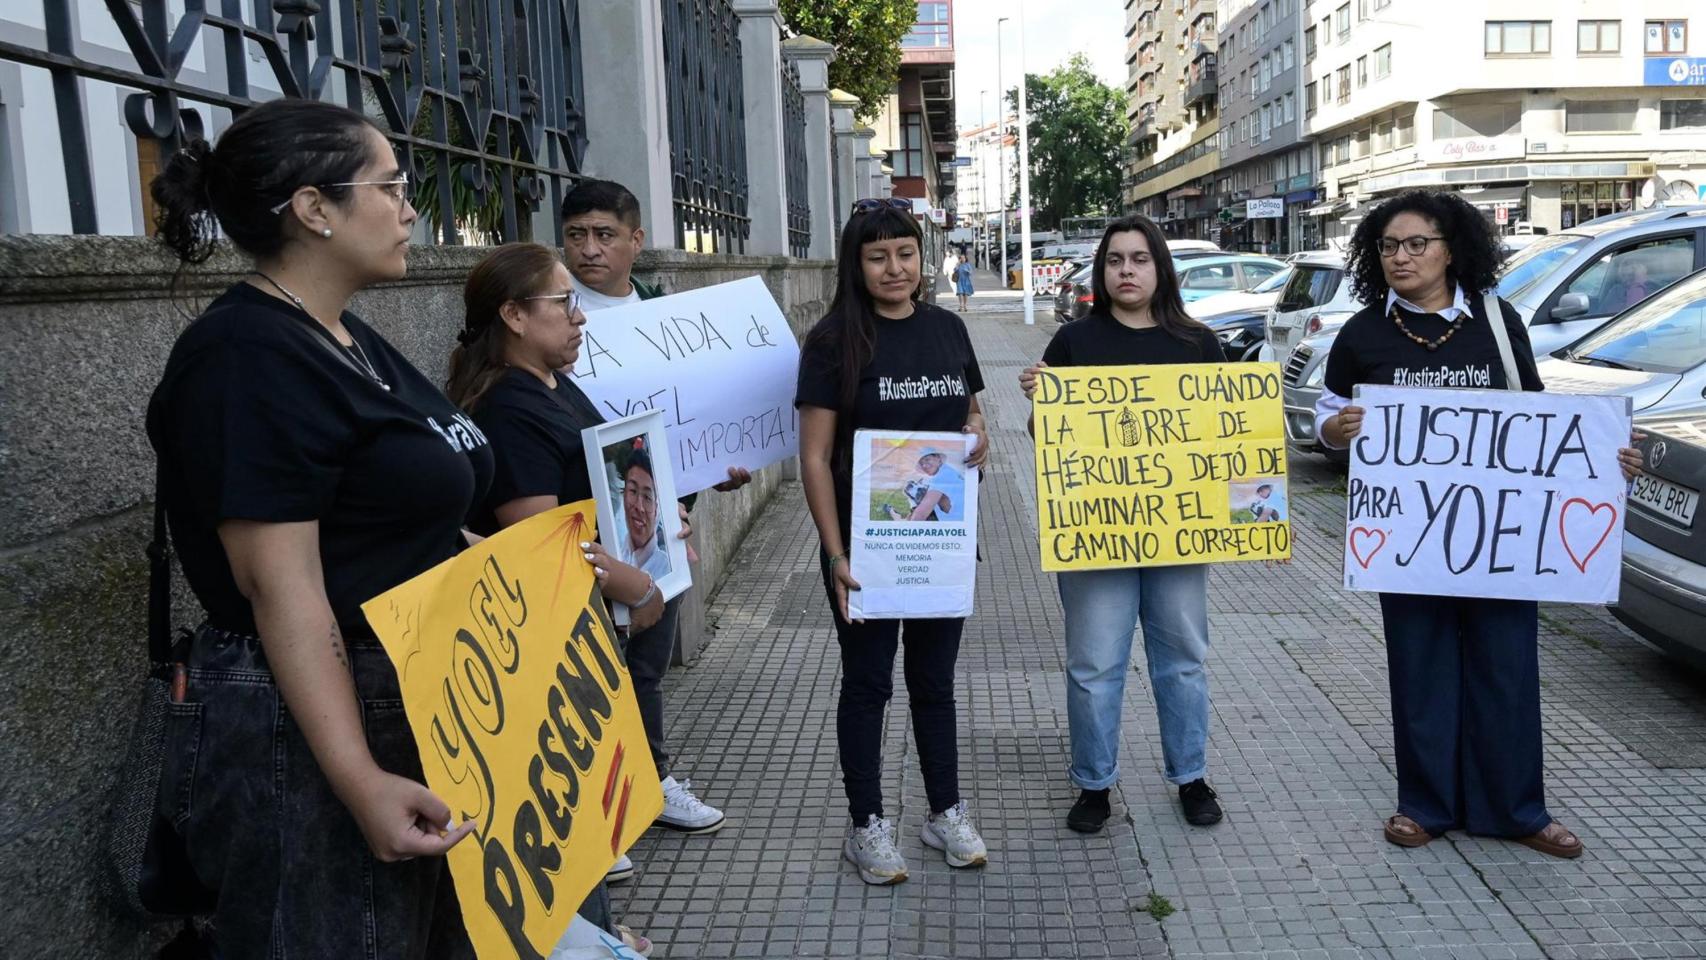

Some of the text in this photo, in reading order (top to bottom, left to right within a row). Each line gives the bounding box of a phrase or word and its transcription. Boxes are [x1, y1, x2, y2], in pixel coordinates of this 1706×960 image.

[635, 312, 732, 361] VIDA
[746, 314, 777, 348] de
[879, 375, 966, 401] #XustizaParaYoel
[1037, 367, 1280, 405] DESDE CUÁNDO
[1393, 364, 1490, 387] #XustizaParaYoel
[679, 404, 796, 472] IMPORTA!
[1043, 414, 1075, 445] LA
[1217, 411, 1252, 439] DE
[1355, 403, 1598, 479] JUSTICIA
[1041, 443, 1285, 496] HÉRCULES DEJÓ DE
[1048, 491, 1213, 530] ILUMINAR EL
[1633, 474, 1691, 520] 5294 BRL
[864, 542, 893, 550] NUNCA
[896, 542, 940, 550] OLVIDEMOS
[865, 528, 967, 537] #JUSTICIAPARAYOEL
[1054, 524, 1288, 563] CAMINO CORRECTO
[1350, 478, 1558, 576] PARA YOEL
[896, 577, 930, 585] JUSTICIA
[431, 553, 528, 851] YOEL
